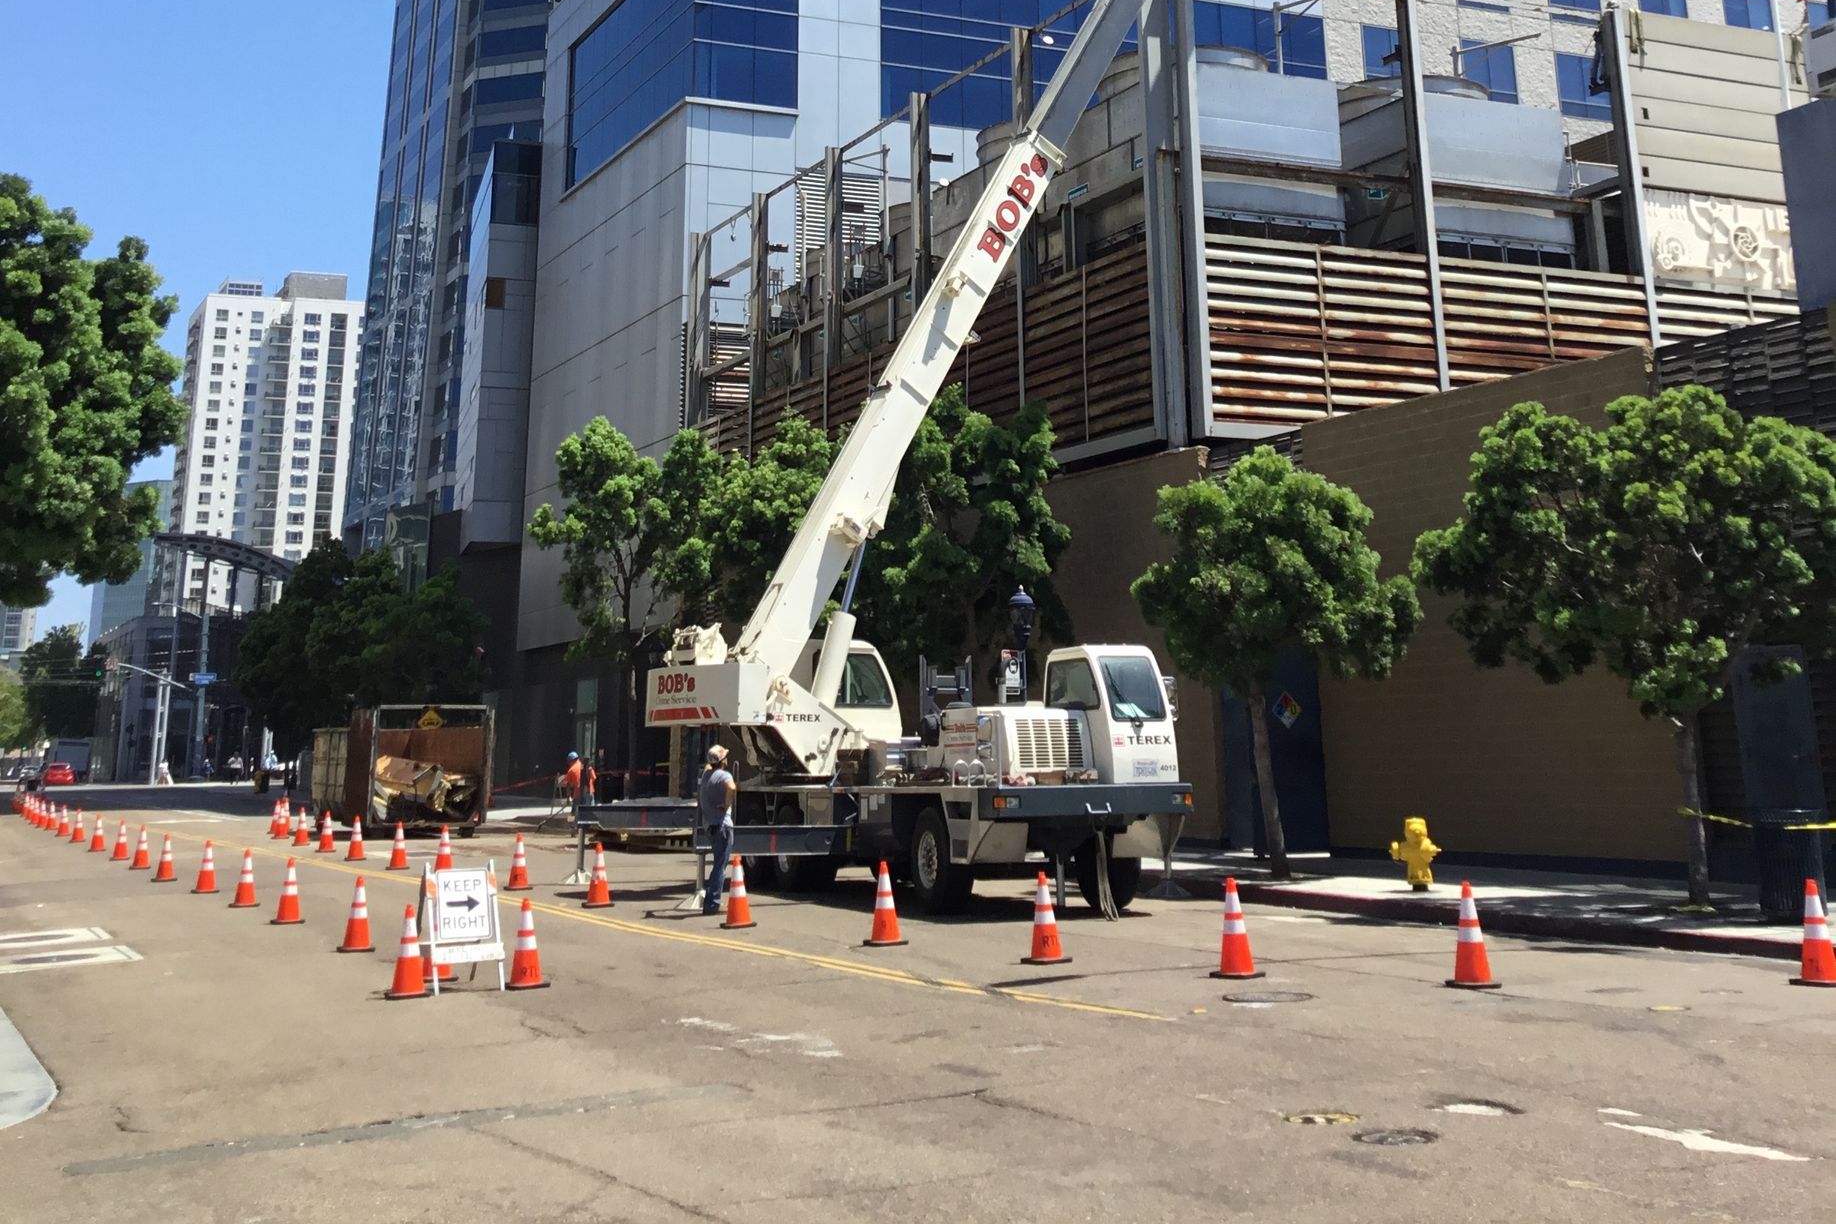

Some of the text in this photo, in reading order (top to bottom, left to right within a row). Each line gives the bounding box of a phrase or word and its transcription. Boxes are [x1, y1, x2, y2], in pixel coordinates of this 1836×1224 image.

[671, 695, 697, 705] Service
[785, 713, 821, 723] TEREX
[1127, 735, 1172, 745] TEREX
[1160, 764, 1177, 772] 4012
[443, 878, 482, 893] KEEP
[442, 915, 486, 930] RIGHT
